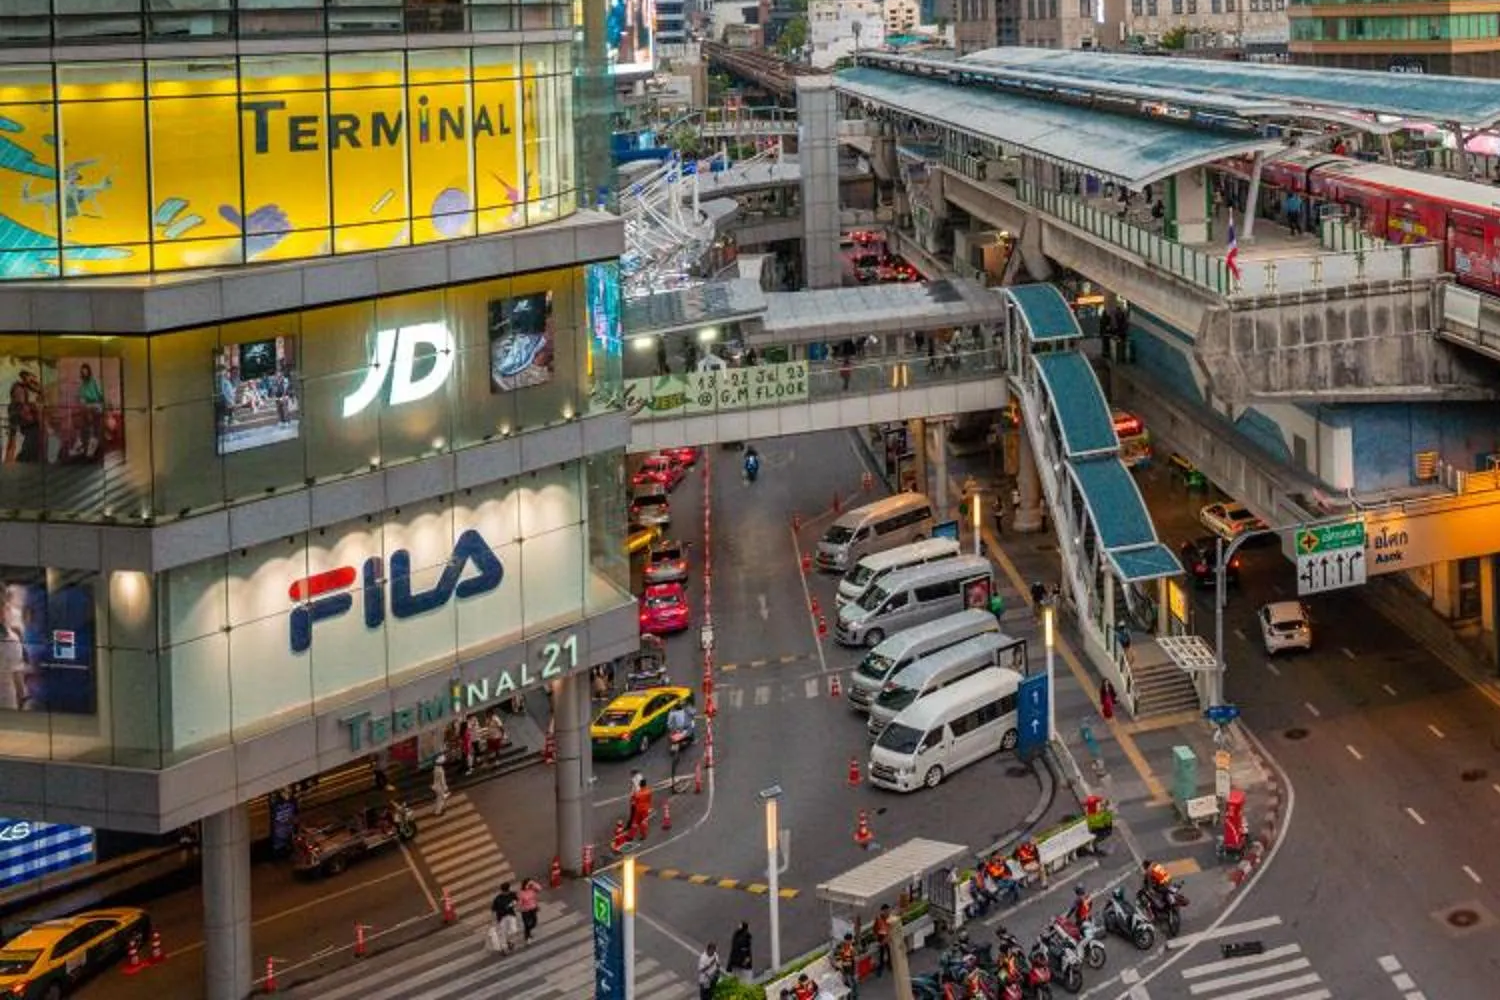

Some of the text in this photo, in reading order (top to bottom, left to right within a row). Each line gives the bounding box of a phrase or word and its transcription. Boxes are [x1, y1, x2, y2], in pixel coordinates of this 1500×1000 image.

[343, 320, 456, 418] JD
[787, 365, 805, 380] 23
[288, 529, 504, 653] FILA
[540, 635, 577, 679] 21
